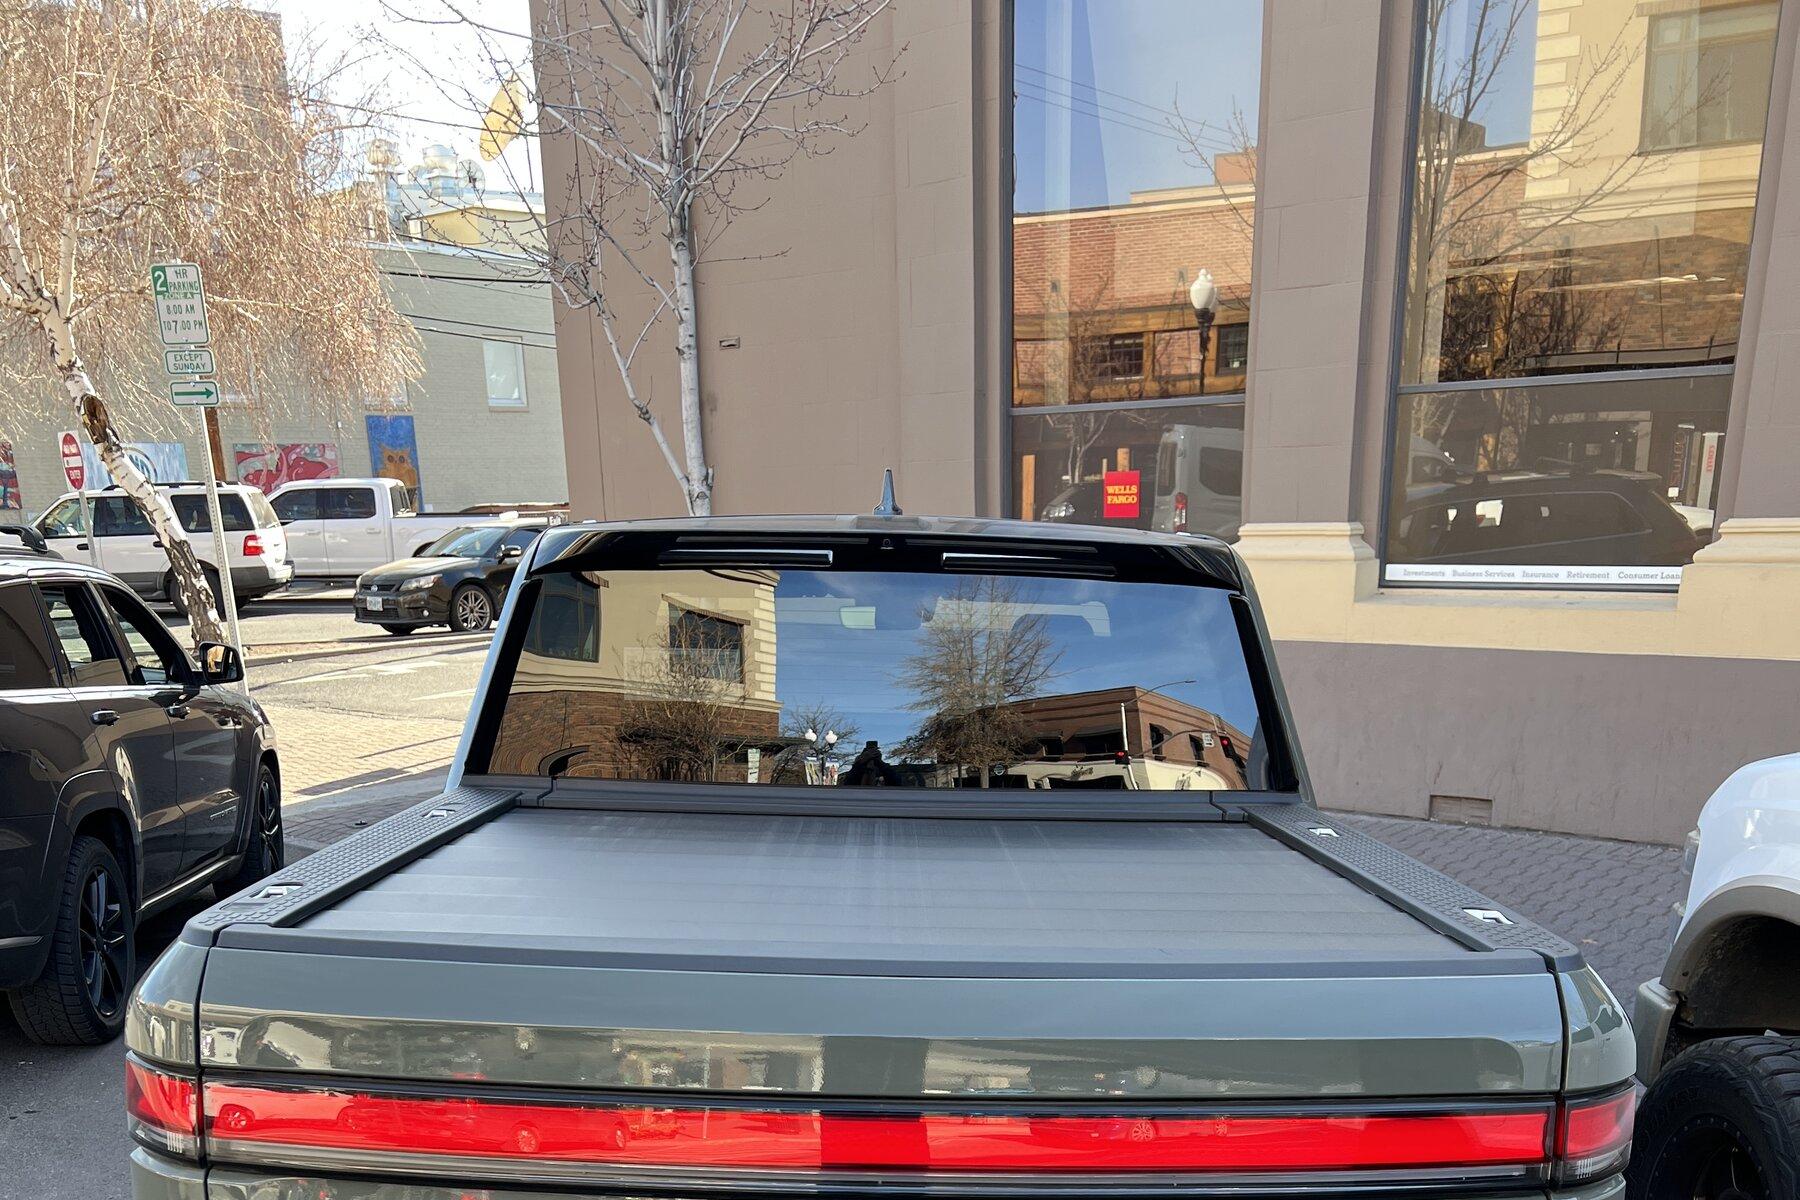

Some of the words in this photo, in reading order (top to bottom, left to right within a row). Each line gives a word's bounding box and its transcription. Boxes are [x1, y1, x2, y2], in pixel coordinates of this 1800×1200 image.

[175, 269, 188, 279] HR
[154, 271, 167, 292] 2
[169, 281, 199, 292] PARKING
[185, 304, 196, 314] AM
[163, 320, 172, 331] TO
[193, 320, 204, 331] PM
[174, 353, 203, 362] EXCEPT
[173, 362, 206, 371] SUNDAY
[1106, 485, 1138, 494] WELLS
[1106, 495, 1138, 504] FARGO
[1403, 568, 1446, 577] Investments
[1452, 569, 1483, 578] Business
[1484, 569, 1516, 578] Services
[1522, 570, 1560, 579] Insurance
[1567, 570, 1610, 579] Retirement
[1618, 571, 1658, 580] Consumer
